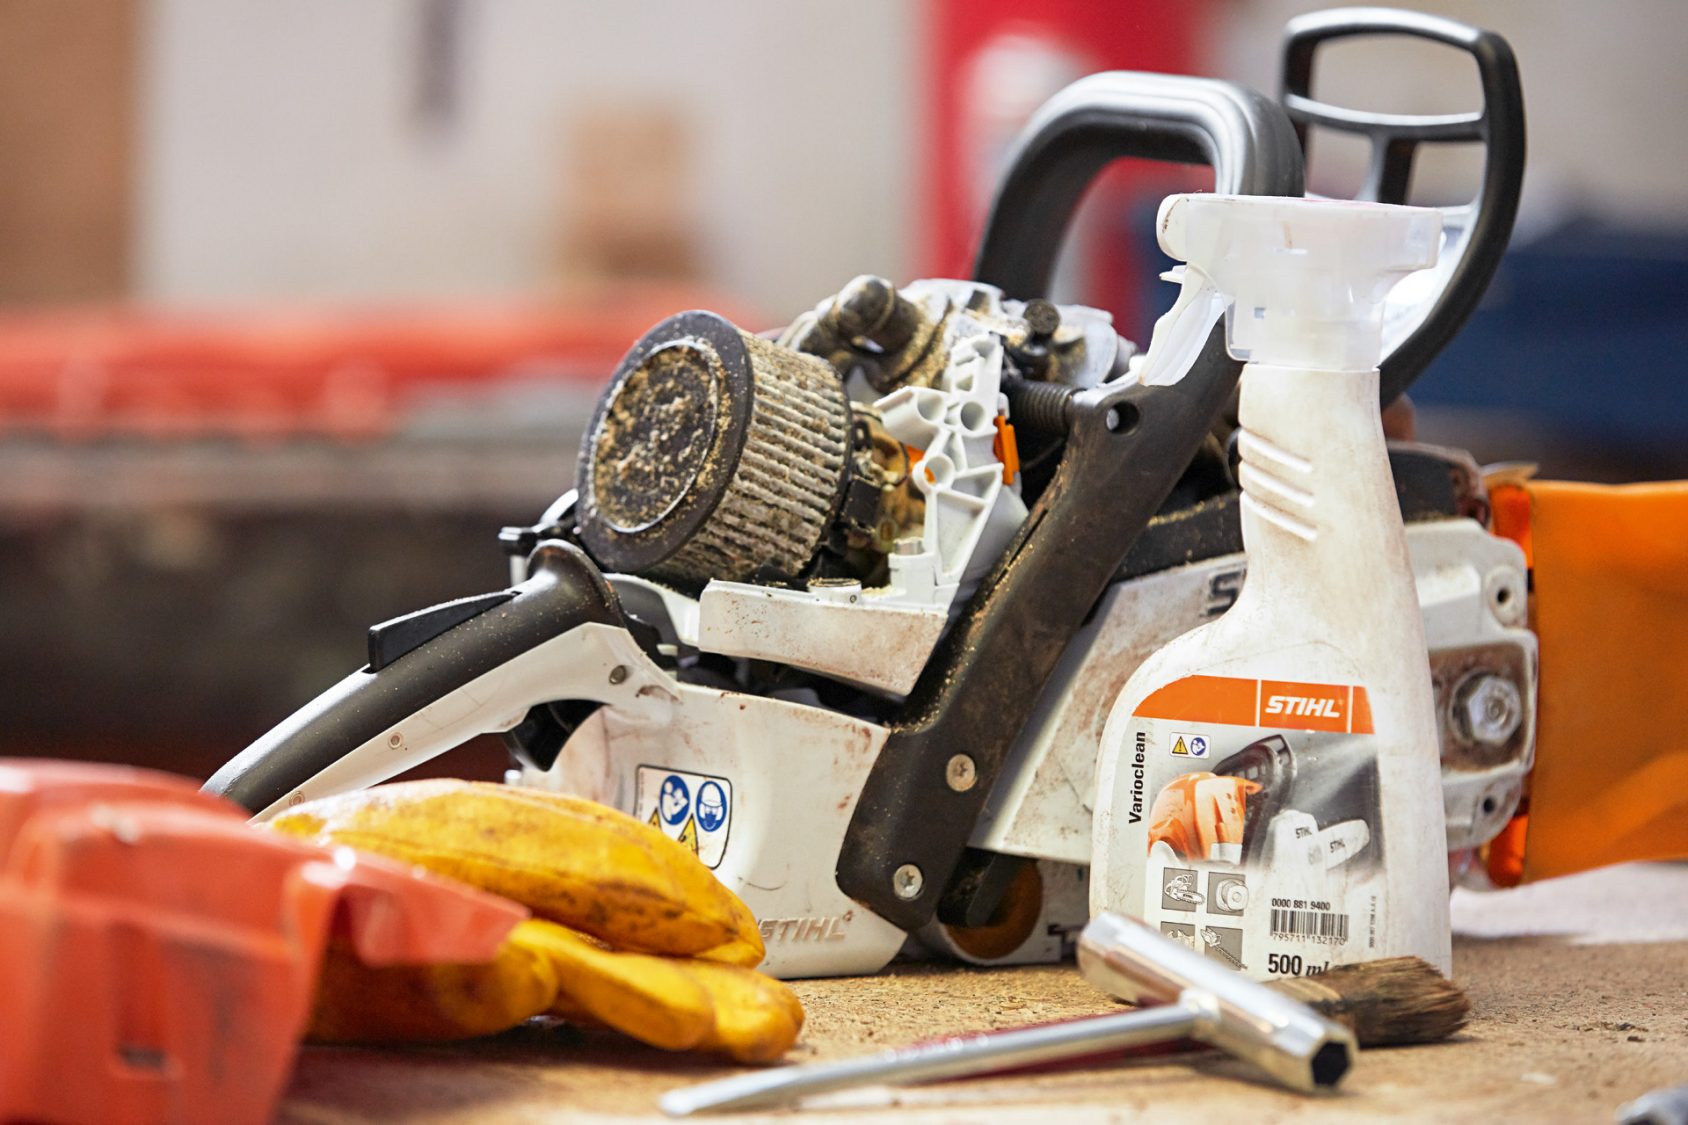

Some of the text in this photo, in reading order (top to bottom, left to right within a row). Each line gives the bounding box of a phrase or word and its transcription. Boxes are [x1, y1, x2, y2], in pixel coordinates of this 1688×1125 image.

[1265, 695, 1341, 718] STIHL
[1128, 732, 1146, 824] Varioclean
[1271, 897, 1331, 911] 0000 881 9400
[757, 917, 846, 942] STIHL
[1268, 953, 1303, 976] 500
